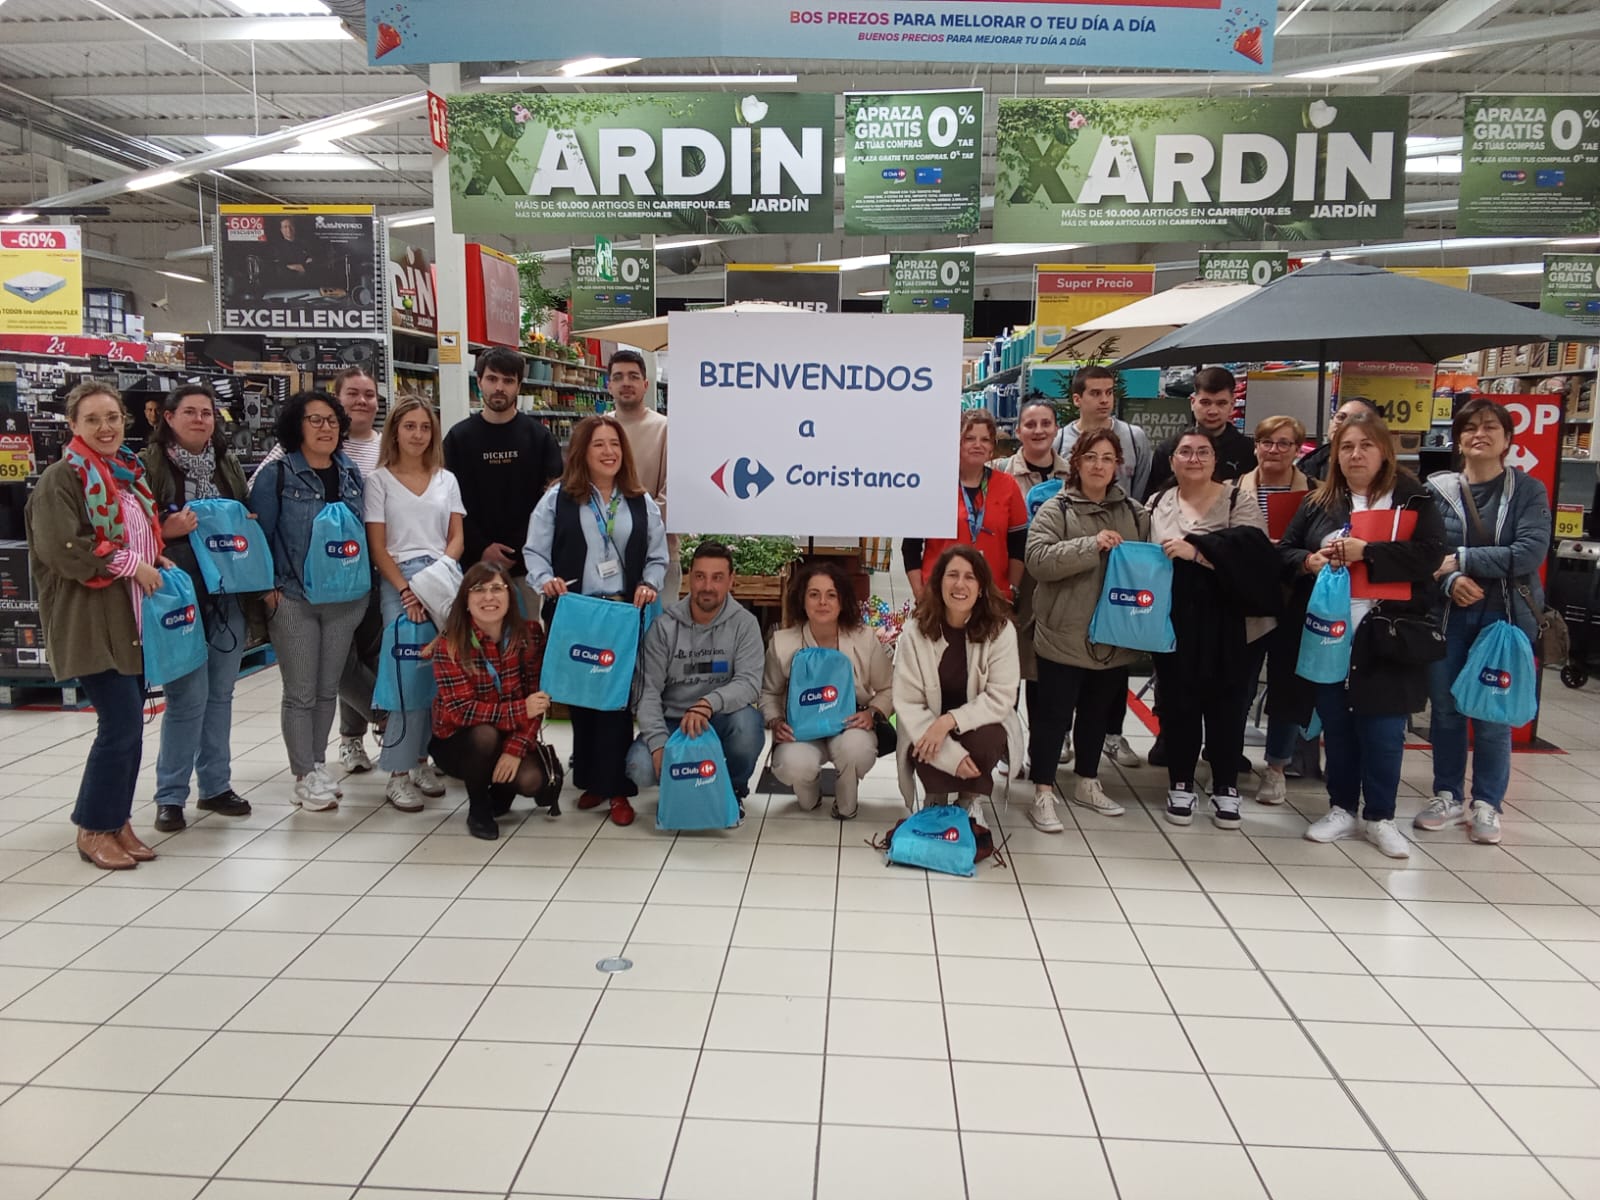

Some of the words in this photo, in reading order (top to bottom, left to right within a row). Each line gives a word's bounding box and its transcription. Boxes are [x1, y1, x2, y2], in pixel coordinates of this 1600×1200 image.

[790, 11, 823, 24] BOS
[827, 11, 889, 25] PREZOS
[894, 13, 936, 26] PARA
[940, 14, 1026, 29] MELLORAR
[1030, 16, 1042, 28] O
[1047, 17, 1077, 30] TEU
[1082, 14, 1109, 31] DÍA
[1113, 19, 1124, 31] A
[1129, 15, 1156, 32] DÍA
[858, 32, 899, 41] BUENOS
[901, 33, 944, 42] PRECIOS
[946, 34, 972, 43] PARA
[975, 35, 1022, 44] MEJORAR
[1025, 36, 1038, 45] TU
[1040, 34, 1057, 45] DÍA
[1060, 37, 1067, 45] A
[1069, 35, 1086, 46] DÍA
[855, 106, 923, 121] APRAZA
[1474, 108, 1547, 122] APRAZA
[855, 121, 921, 138] GRATIS
[1473, 123, 1544, 140] GRATIS
[855, 140, 865, 149] AS
[886, 139, 923, 149] COMPRAS
[958, 139, 974, 147] TAE
[1472, 142, 1484, 150] AS
[1505, 142, 1546, 150] COMPRAS
[541, 201, 554, 209] DE
[556, 201, 589, 209] 10.000
[591, 201, 635, 209] ARTIGOS
[637, 201, 651, 209] EN
[652, 201, 730, 209] CARREFOUR.ES
[748, 195, 809, 212] JARDÍN
[1089, 209, 1102, 217] DE
[1104, 208, 1139, 217] 10.000
[1142, 208, 1188, 217] ARTIGOS
[1191, 208, 1205, 216] EN
[1208, 207, 1291, 216] CARREFOUR.ES
[1310, 201, 1376, 218] JARDÍN
[225, 218, 263, 230] -60%
[1169, 218, 1228, 226] CARREFOUR.ES
[11, 233, 56, 247] -60%
[577, 256, 619, 265] APRA
[896, 260, 938, 270] APRAZA
[1205, 260, 1249, 270] APRAZA
[577, 266, 618, 276] GRS
[1550, 262, 1593, 272] APRAZA
[895, 270, 937, 280] GRATIS
[1205, 270, 1248, 280] GRATIS
[1549, 272, 1592, 282] GRATIS
[1056, 278, 1091, 291] Super
[1096, 278, 1133, 289] Precio
[225, 309, 375, 328] EXCELLENCE
[1389, 363, 1419, 372] Precio
[699, 361, 933, 391] BIENVENIDOS
[1383, 399, 1411, 423] 49
[1415, 401, 1423, 412] €
[1131, 413, 1188, 425] APRAZA
[1504, 403, 1561, 435] OP
[798, 419, 815, 437] a
[1143, 425, 1182, 438] RATI
[483, 450, 519, 460] DICKIES
[786, 464, 921, 489] Coristanco
[1560, 522, 1573, 533] 99
[1119, 593, 1136, 602] Club
[0, 602, 39, 610] CELLENCE
[1312, 621, 1330, 632] Club
[581, 650, 599, 661] Club
[681, 767, 699, 775] Club
